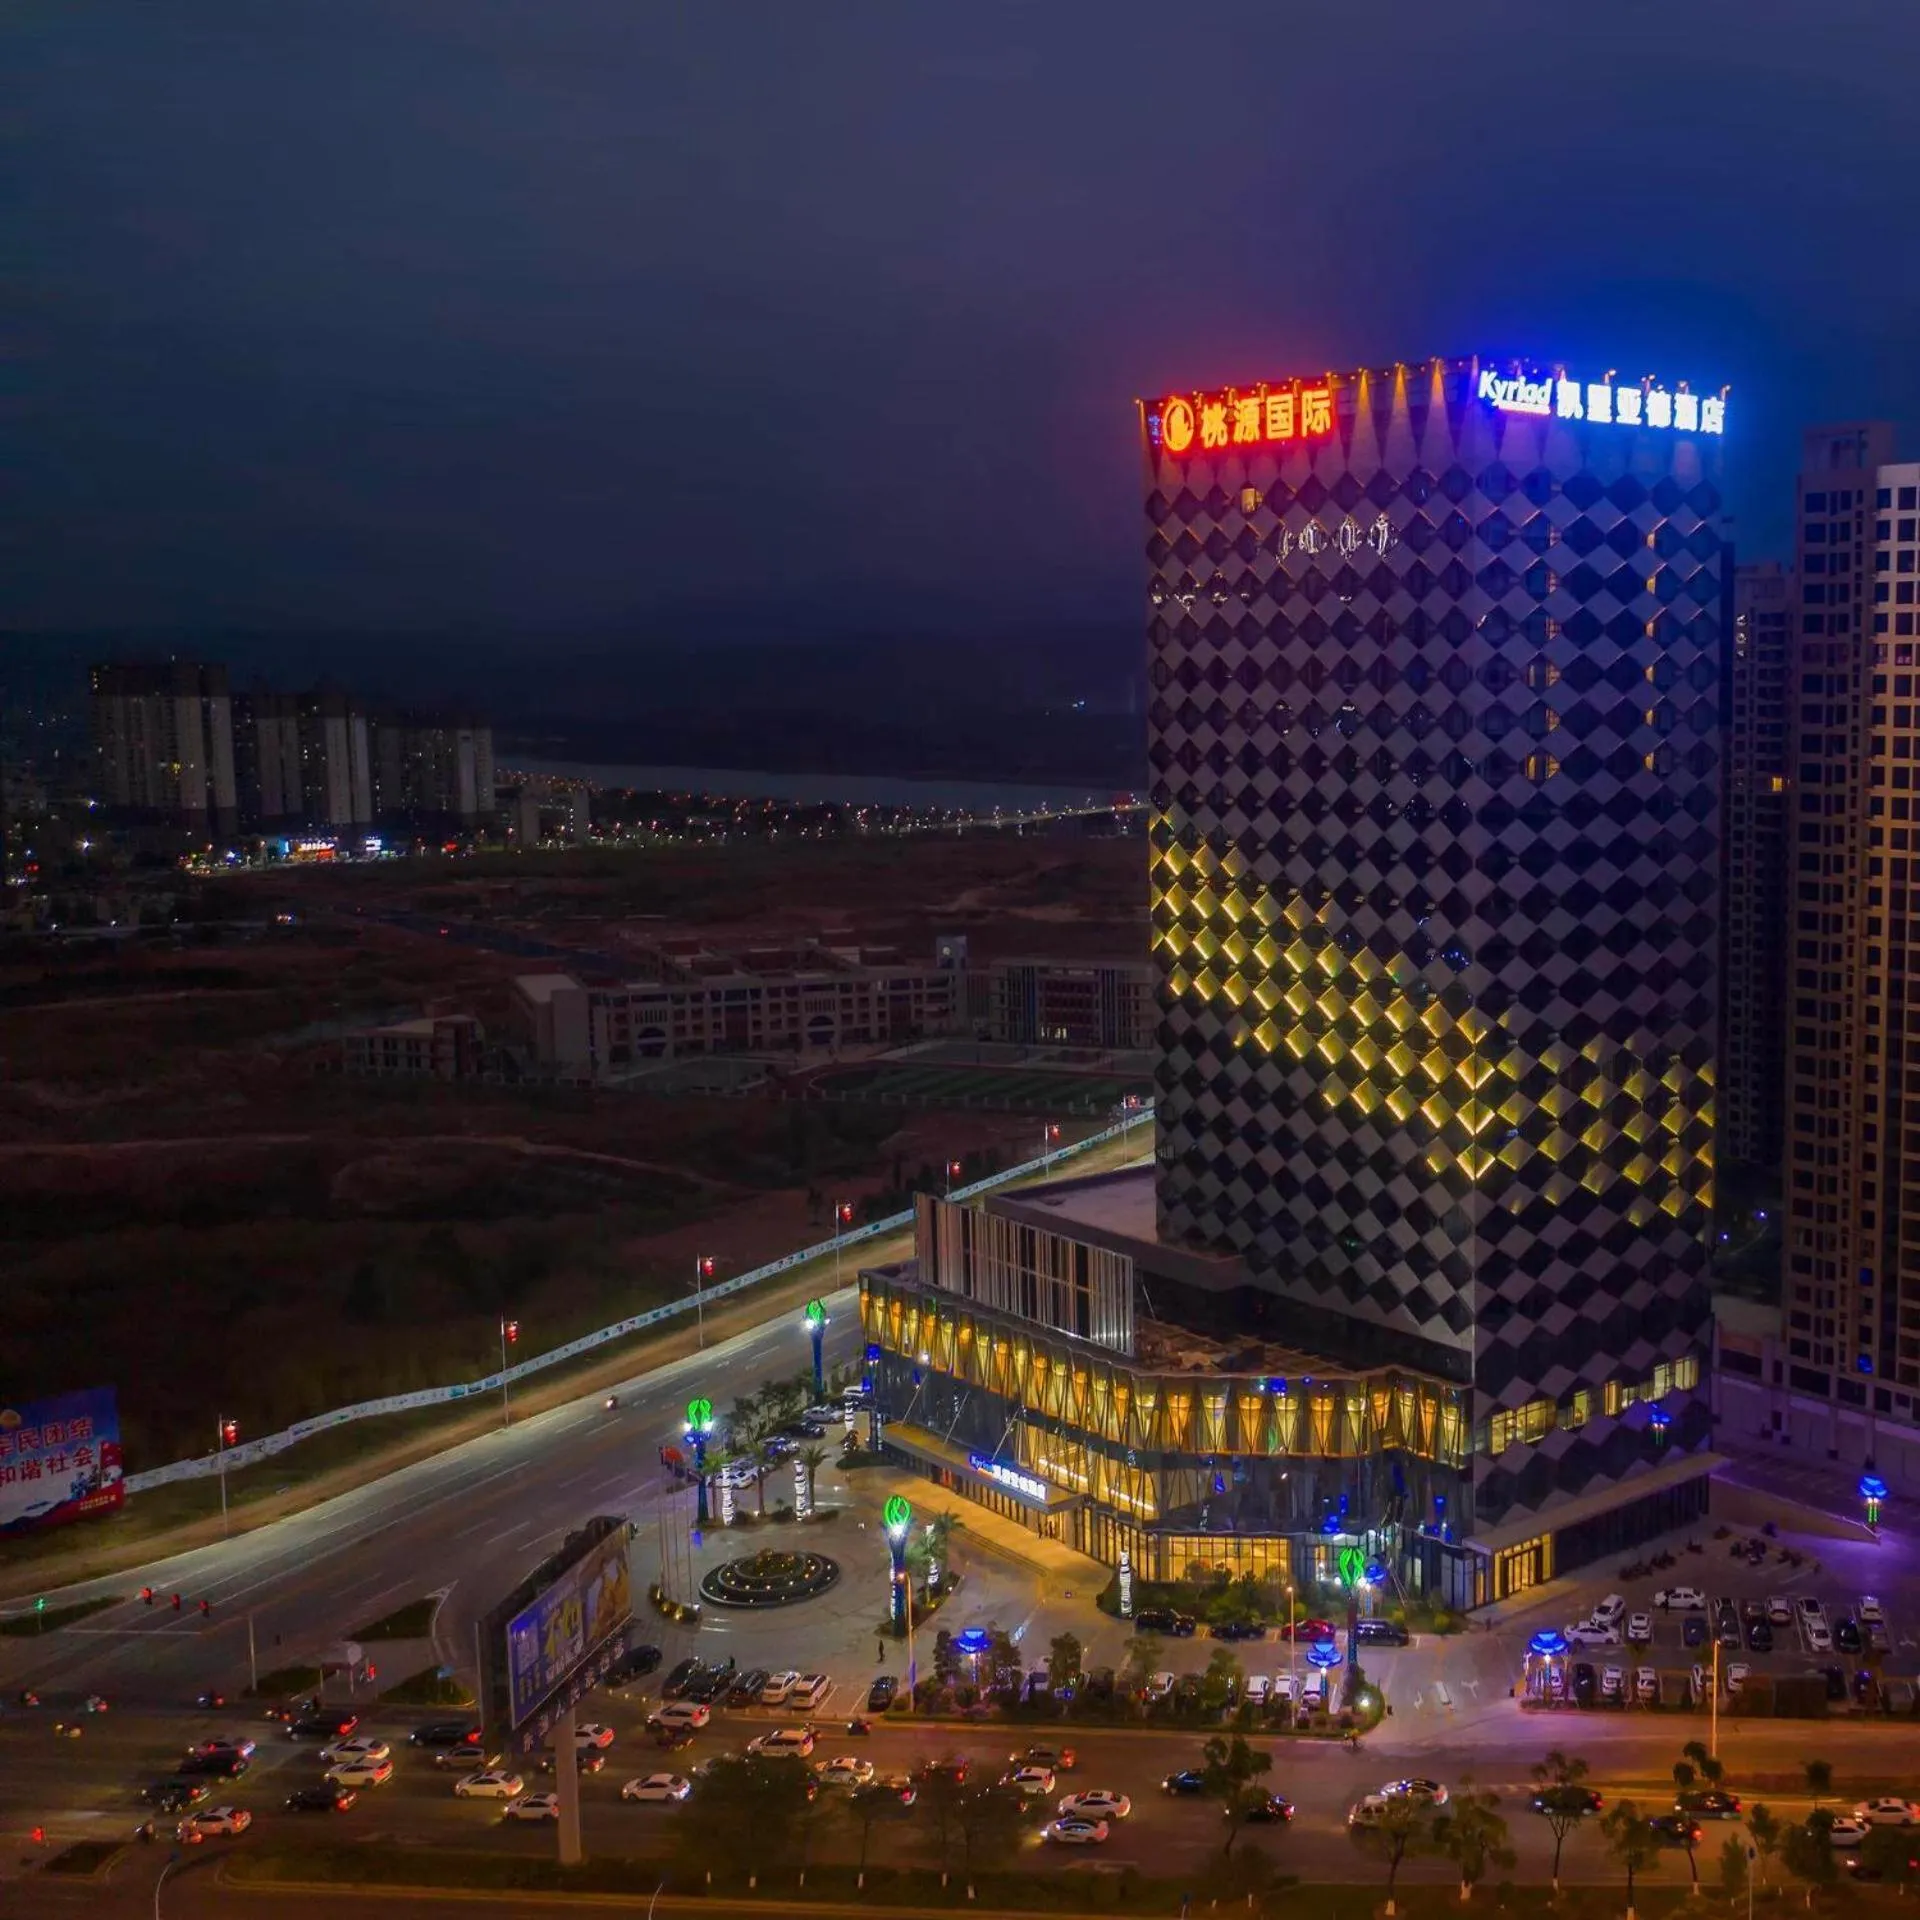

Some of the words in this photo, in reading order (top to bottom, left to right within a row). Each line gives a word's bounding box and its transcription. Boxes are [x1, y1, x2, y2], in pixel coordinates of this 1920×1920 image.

[1479, 371, 1552, 406] Kyriad
[1200, 389, 1331, 449] 桃源国际
